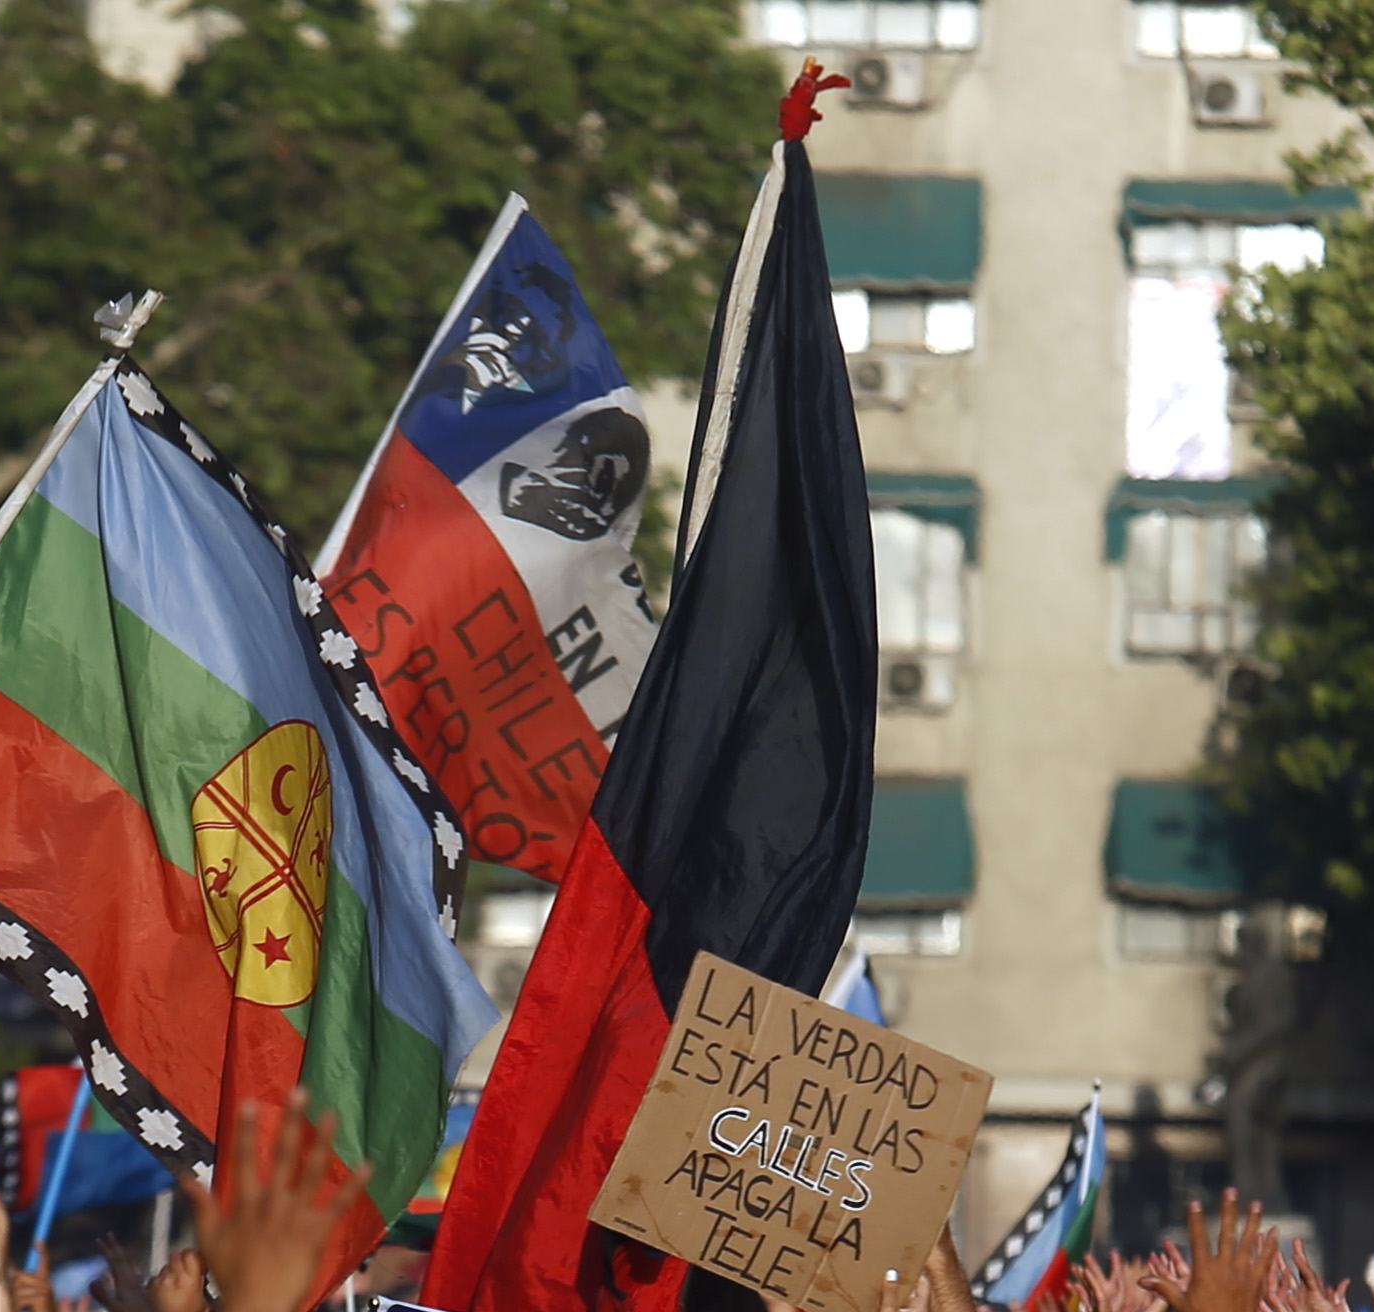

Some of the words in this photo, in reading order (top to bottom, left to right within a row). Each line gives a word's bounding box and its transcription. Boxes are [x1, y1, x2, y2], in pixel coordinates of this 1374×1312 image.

[545, 604, 618, 694] EN
[695, 968, 755, 1036] LA
[789, 1008, 939, 1110] VERDAD
[670, 1028, 782, 1104] ESTÁ
[788, 1078, 847, 1136] EN
[853, 1108, 924, 1174] LAS
[665, 1150, 797, 1228] APAGA
[807, 1200, 863, 1261] LA
[708, 1106, 874, 1211] CALLES
[699, 1206, 806, 1297] TELE
